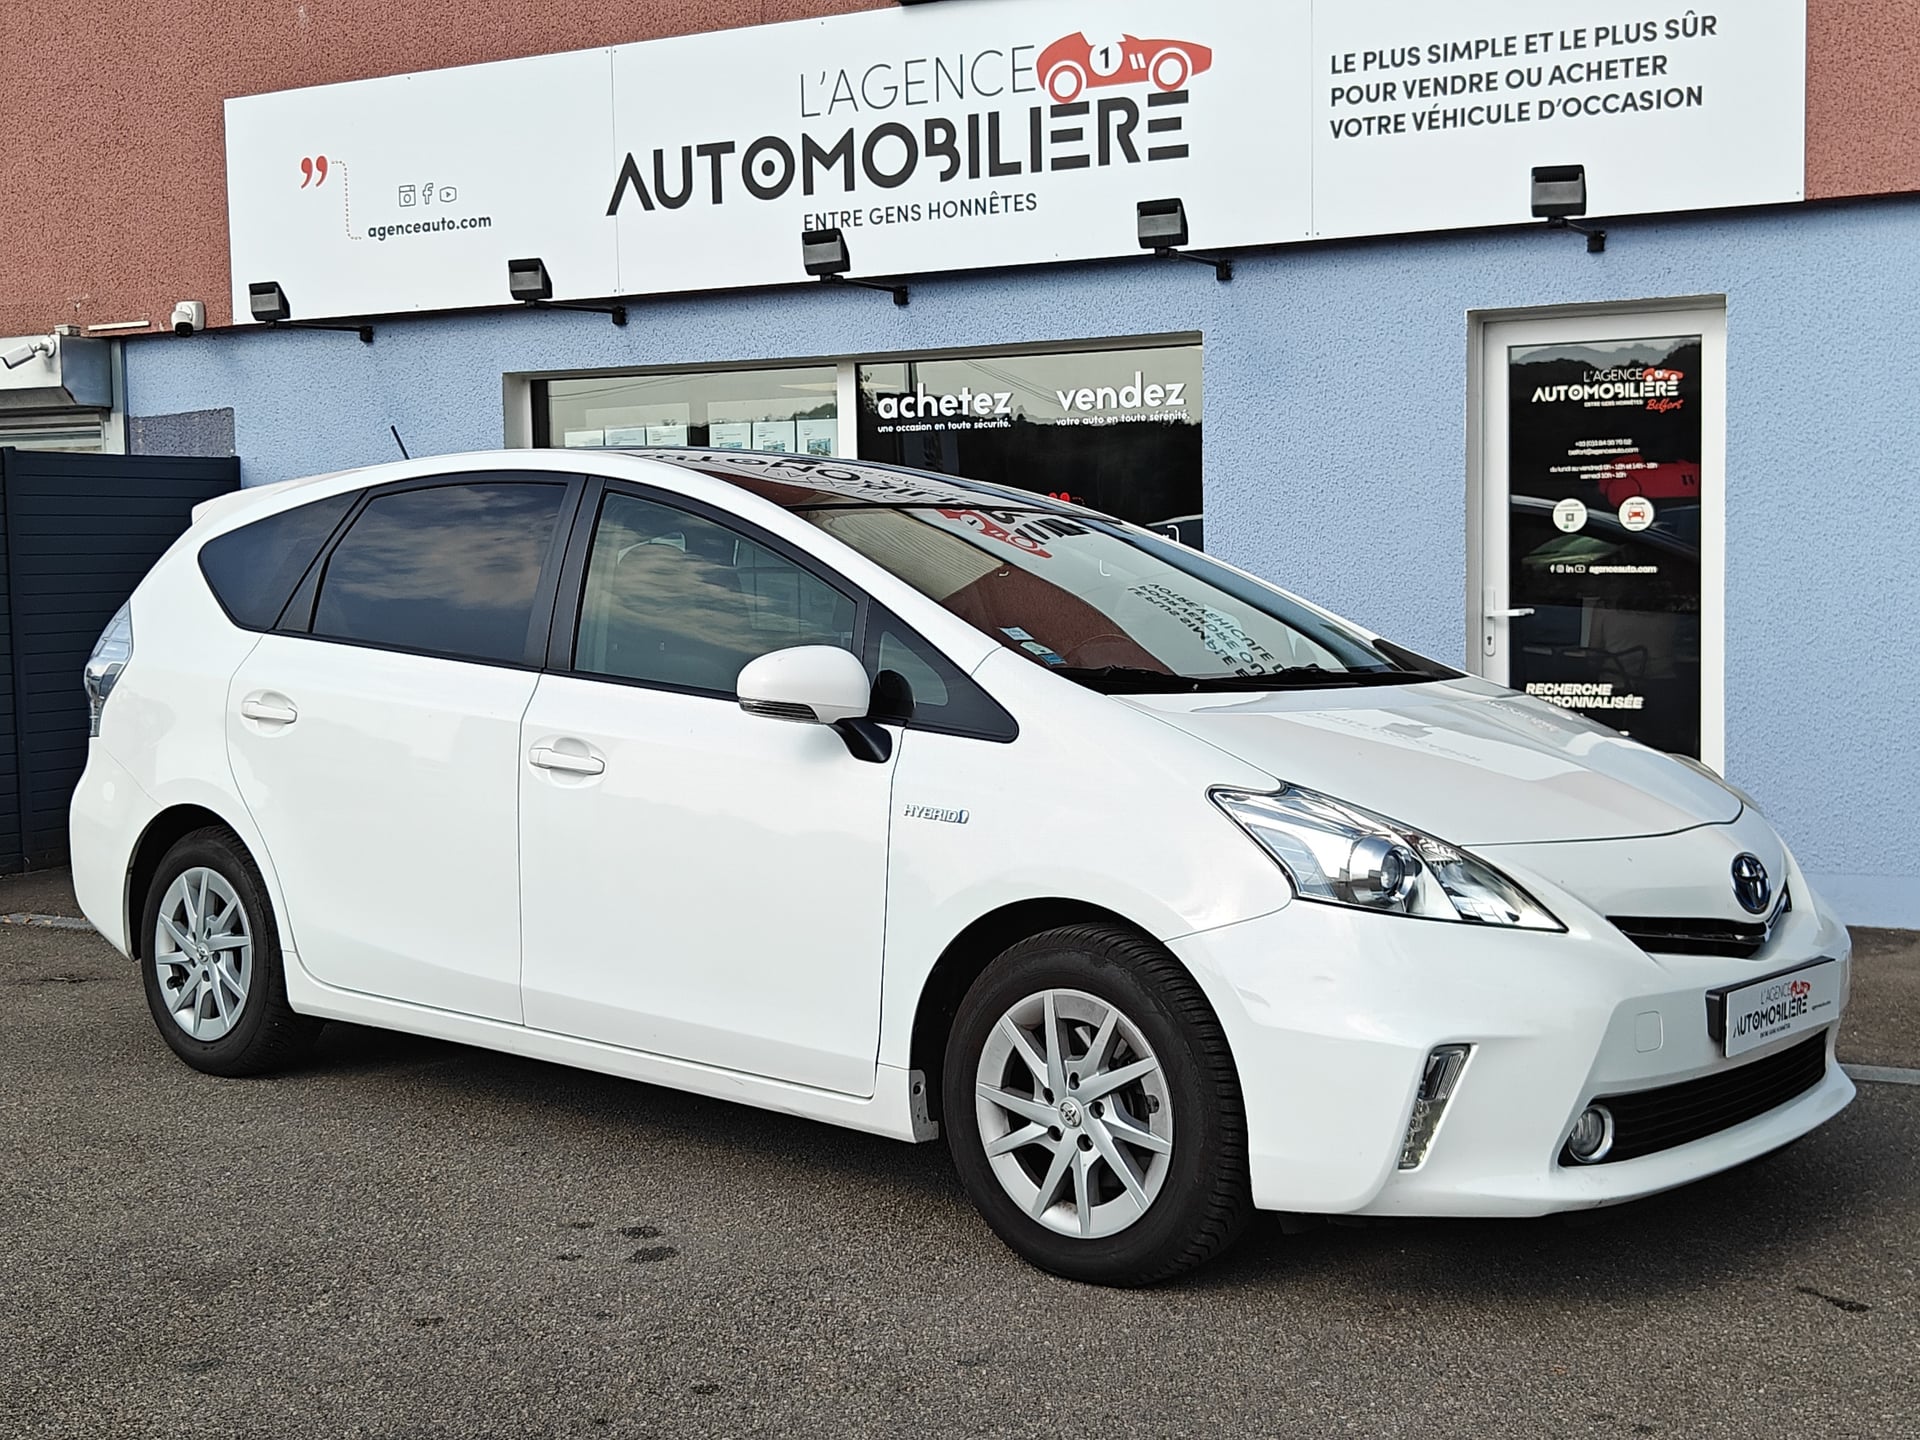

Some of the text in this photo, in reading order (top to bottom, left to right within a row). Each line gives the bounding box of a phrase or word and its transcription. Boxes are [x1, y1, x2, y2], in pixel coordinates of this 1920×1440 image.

[1331, 10, 1718, 75] LE PLUS SIMPLE ET LE PLUS SÛR
[800, 44, 1036, 118] L'AGENCE
[1331, 54, 1668, 107] POUR VENDRE OU ACHETER
[1330, 85, 1703, 139] VOTRE VÉHICULE D'OCCASION
[368, 216, 492, 241] agenceauto.com
[803, 191, 1038, 232] ENTRE GENS HONNÊTES
[1055, 370, 1186, 412] vendez
[1583, 368, 1643, 383] L'AGENCE
[877, 382, 1012, 419] achetez
[1055, 409, 1191, 426] votre auto en toute sérénité.
[877, 417, 1012, 433] une occasion en toute sécurité.
[1526, 683, 1613, 695] RECHERCHE
[903, 804, 959, 823] HYBRID
